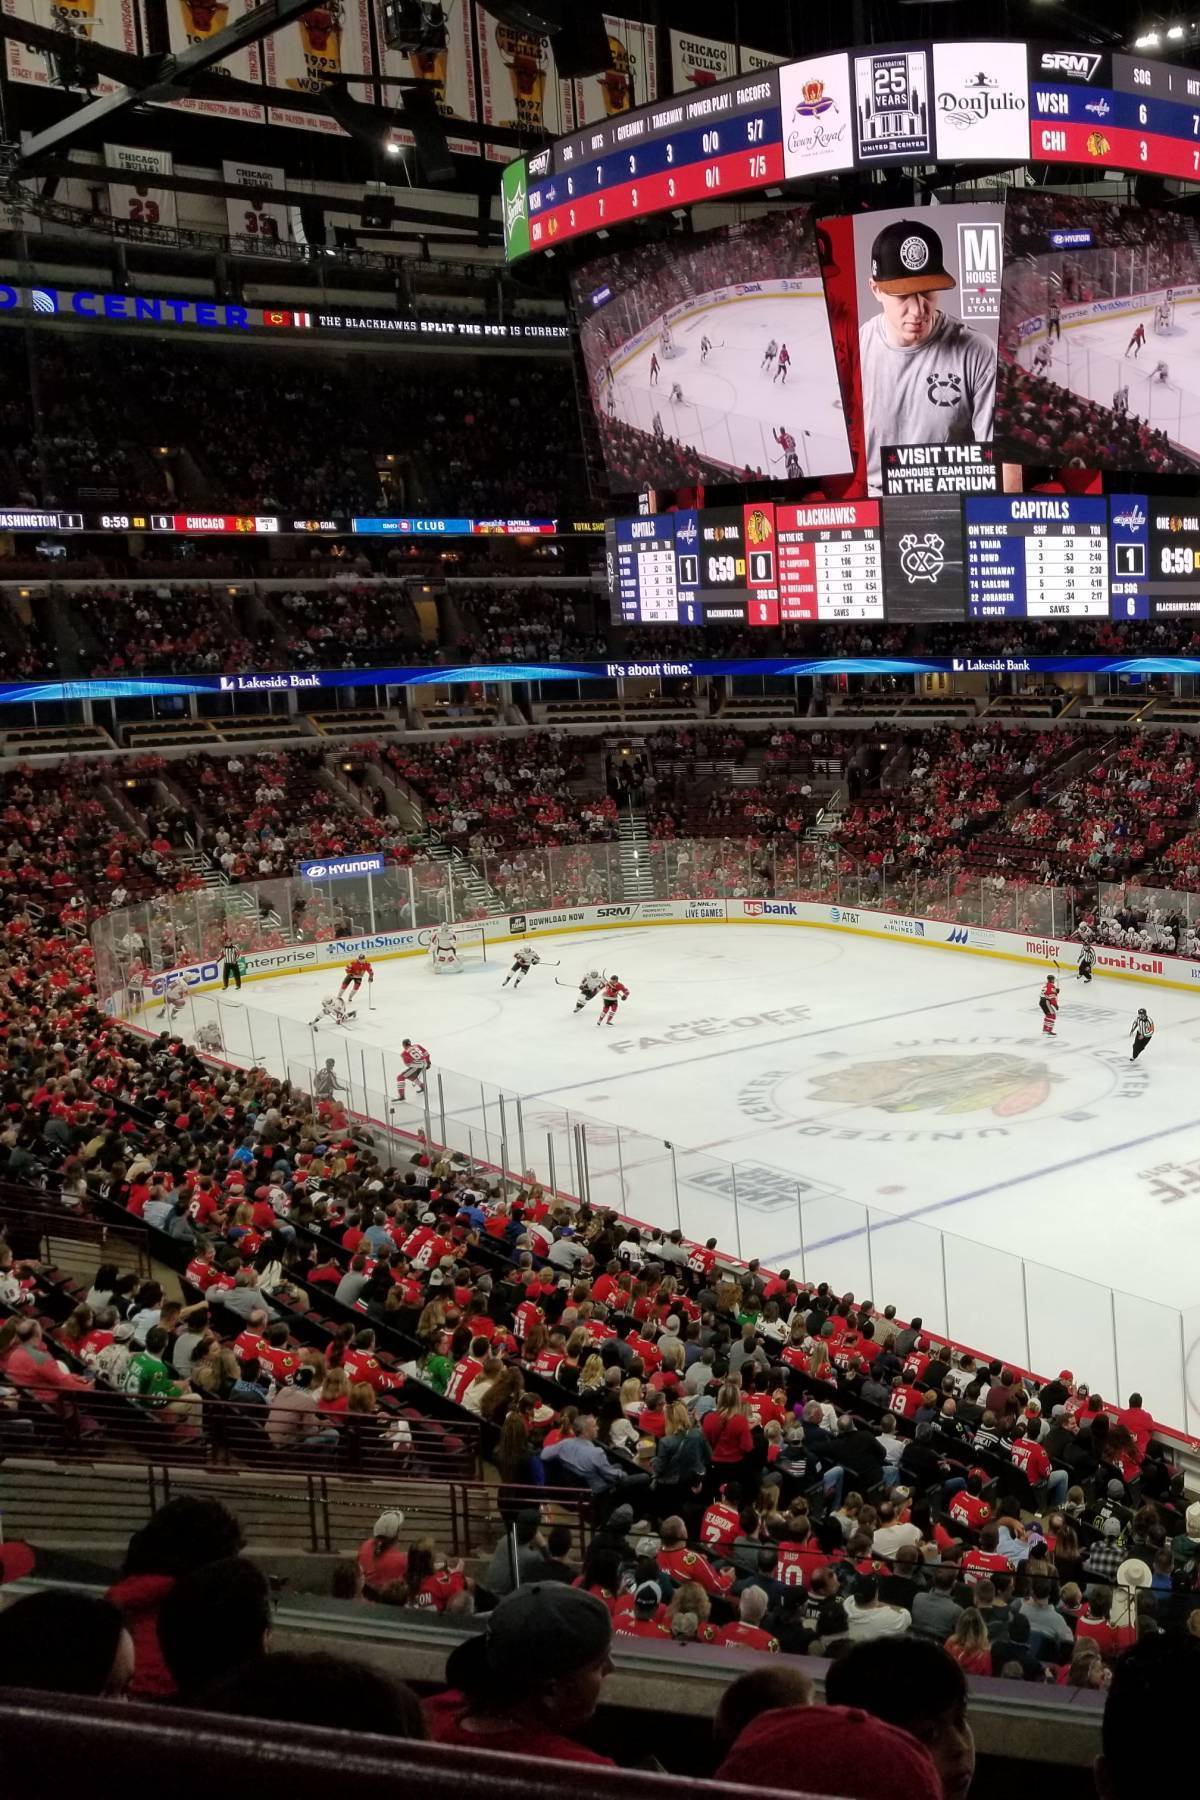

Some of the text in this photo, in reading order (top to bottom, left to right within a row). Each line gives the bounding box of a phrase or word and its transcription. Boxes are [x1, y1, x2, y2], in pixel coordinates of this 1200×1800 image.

[679, 38, 728, 61] CHICAGO
[304, 53, 337, 69] 1993
[687, 53, 723, 73] BULLS
[1041, 53, 1089, 72] SRM
[874, 68, 907, 94] 25
[1133, 68, 1152, 86] SOG
[875, 93, 908, 107] YEARS
[617, 83, 771, 141] GIVEAWAY TAKEAWAY POWER PLAY FACEOFFS
[1036, 92, 1069, 115] WSH
[1139, 104, 1148, 125] 6
[1192, 114, 1200, 135] 7
[666, 118, 765, 164] 3 0/0 5/7
[787, 123, 847, 154] Crown Royal
[862, 140, 925, 153] UNITED CENTER
[118, 152, 160, 165] CHICAGO
[1041, 129, 1067, 152] CHI
[1140, 140, 1148, 162] 3
[1192, 150, 1200, 171] 7
[528, 154, 548, 174] SRM
[236, 168, 273, 181] CHICAGO
[668, 154, 767, 198] 3 0/1 7/5
[129, 198, 160, 224] 23
[964, 229, 998, 271] M
[966, 271, 998, 284] HOUSE
[72, 291, 249, 331] CENTER
[967, 305, 999, 313] STORE
[319, 315, 507, 335] THE BLACKHAWKS SPLIT THE POT
[897, 445, 982, 465] VISIT THE
[887, 465, 996, 479] MADHOUSE TEAM STORE
[888, 476, 997, 494] IN THE ATRIUM
[796, 506, 857, 527] BLACKHAWKS
[1011, 501, 1070, 519] CAPITALS
[101, 515, 130, 529] 8:59
[186, 517, 225, 529] CHICAGO
[416, 520, 445, 531] CLUB
[1156, 516, 1200, 531] ONE GOAL
[708, 555, 735, 582] 8:59
[756, 555, 766, 579] 0
[1126, 547, 1135, 572] 1
[1160, 547, 1194, 574] 8:59
[1124, 583, 1138, 595] SOG
[760, 603, 768, 621] 3
[1049, 605, 1070, 614] SAVES
[1127, 597, 1136, 616] 6
[606, 663, 626, 676] It's
[627, 662, 660, 676] about
[967, 659, 1030, 671] Lakeside Bank
[238, 674, 321, 689] Lakeside Bank
[327, 859, 380, 874] HYUNDAI
[529, 915, 567, 927] DOWNLOAD
[568, 912, 585, 921] NOW
[596, 906, 631, 918] SRM
[685, 908, 724, 919] LIVE GAMES
[841, 911, 861, 925] AT&T
[883, 924, 914, 934] AIRLINES
[889, 919, 913, 927] UNITED
[336, 934, 414, 953] NorthShore
[1026, 940, 1061, 959] meijer
[1097, 955, 1164, 975] uni-ball
[607, 1004, 812, 1055] FACE-OFF
[895, 1035, 1150, 1100] UNITED CENTER
[737, 1069, 1010, 1143] UNITED CENTER
[1135, 1162, 1182, 1181] 2019
